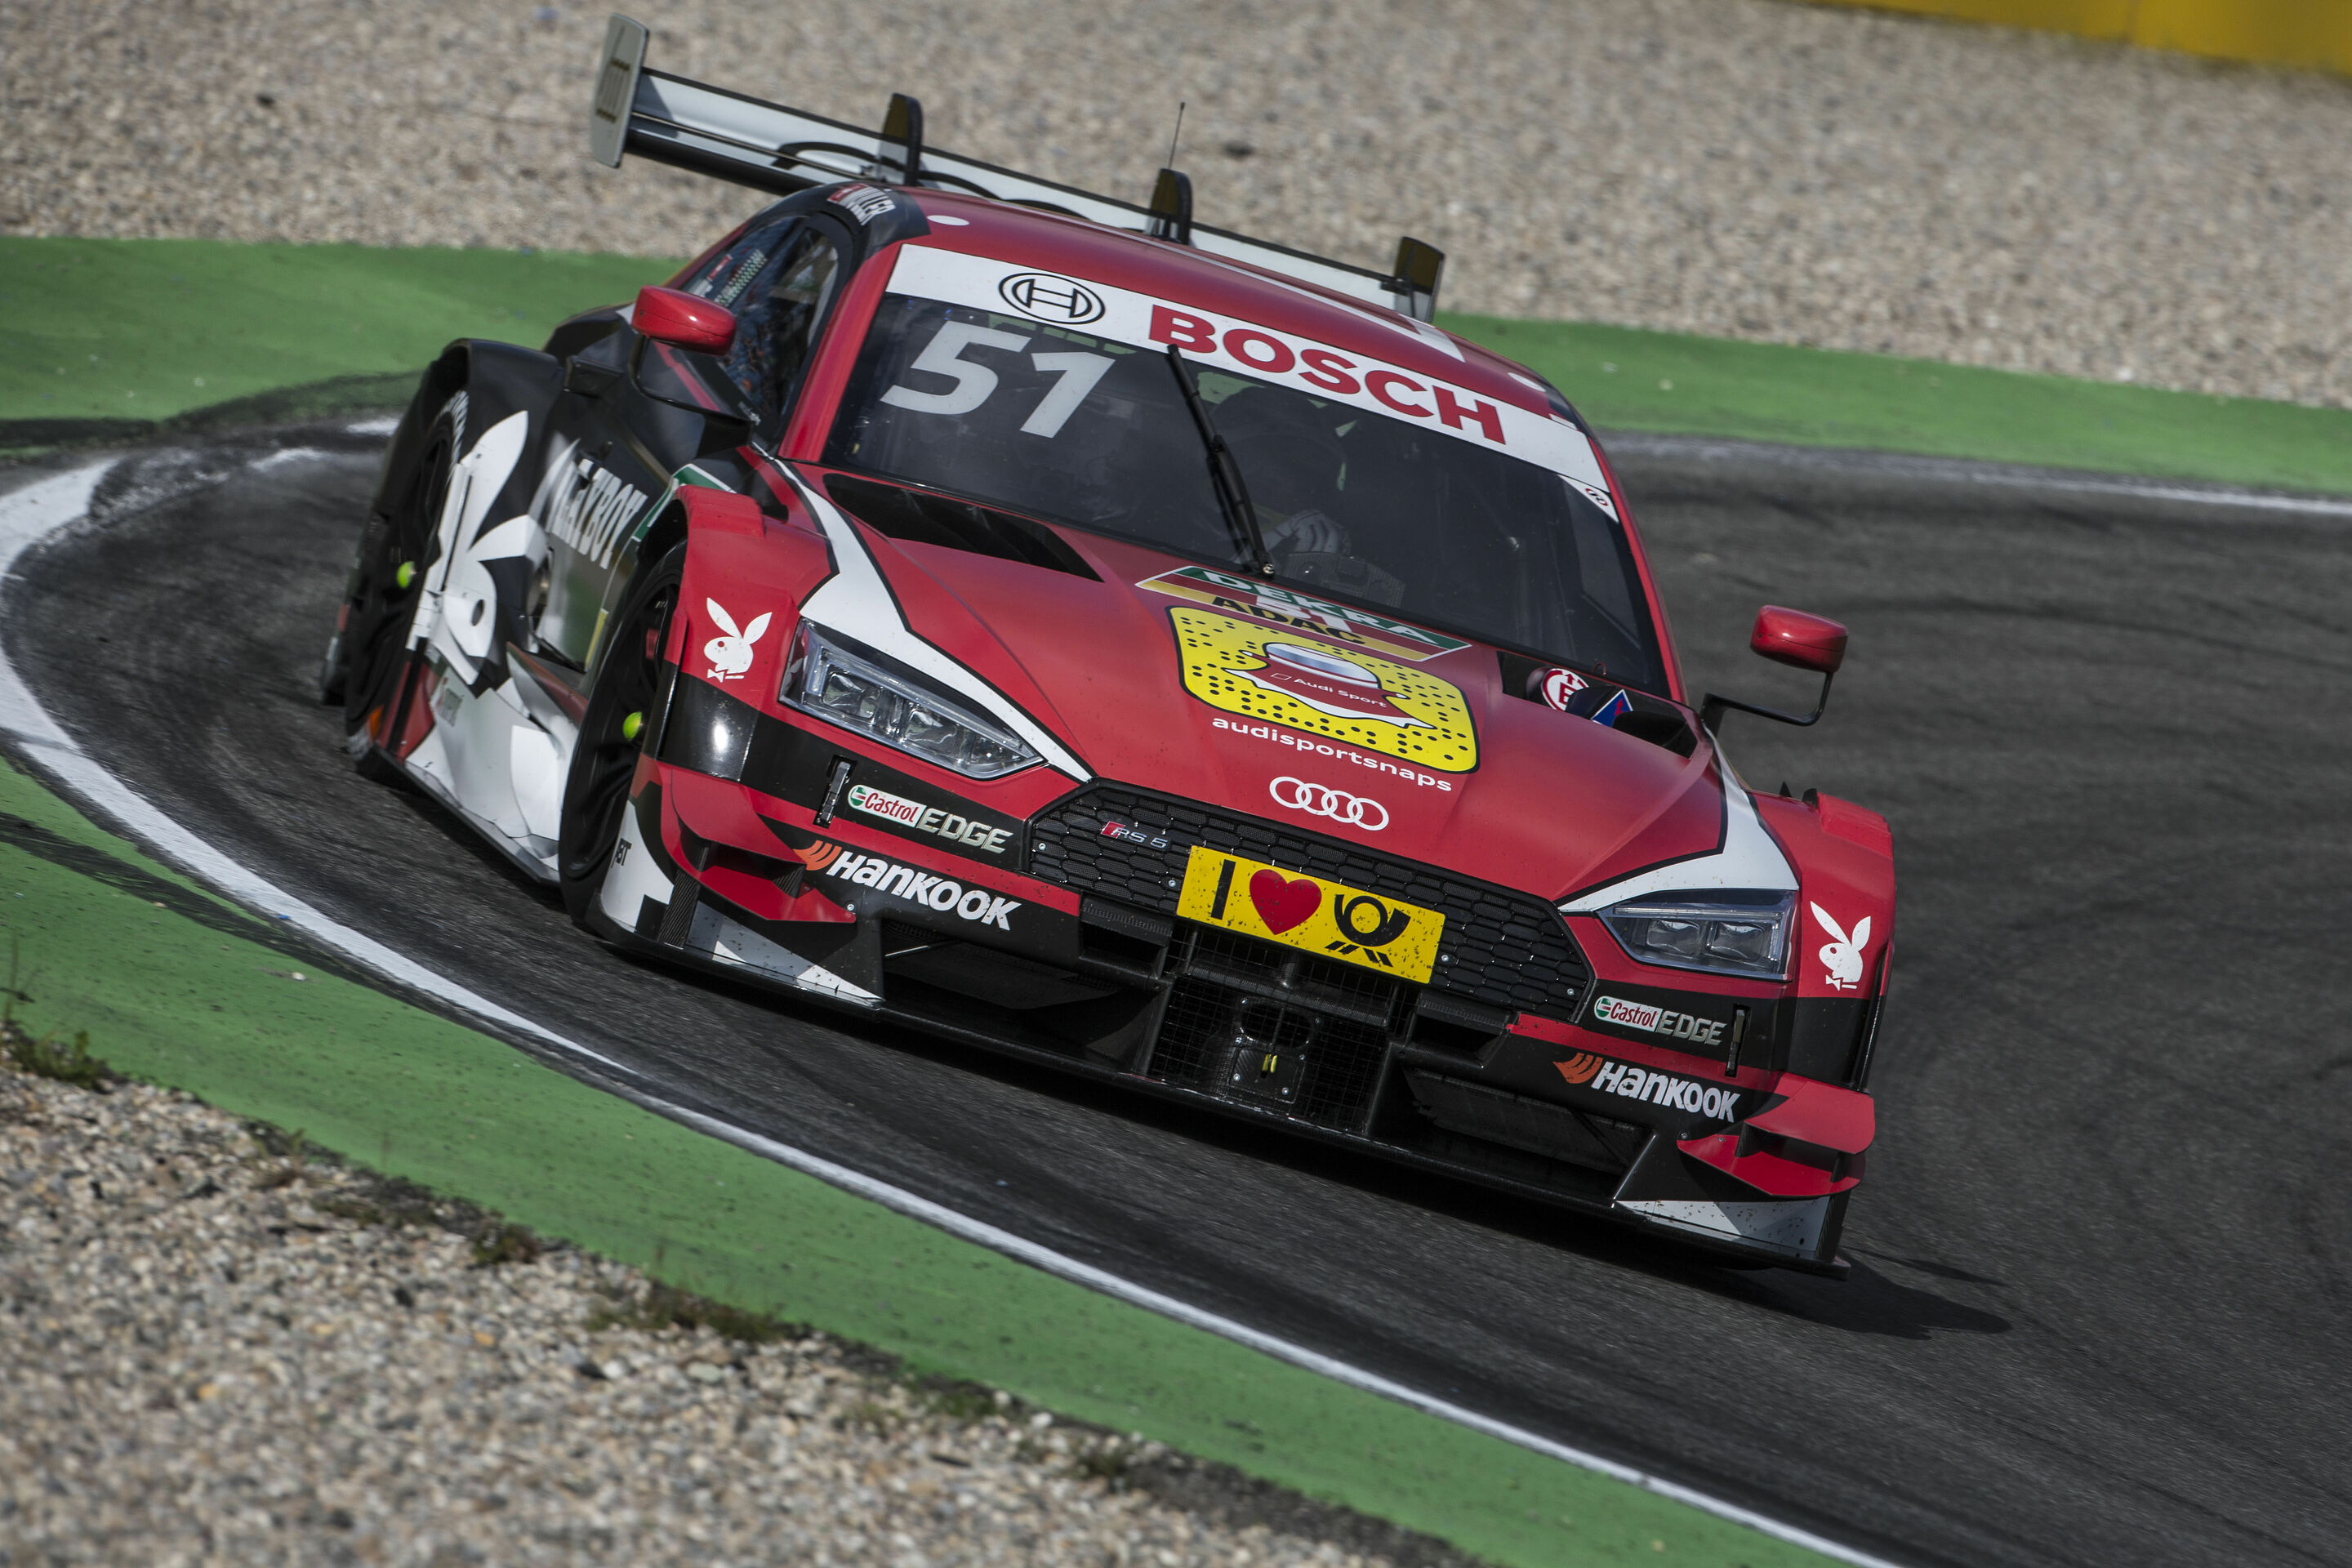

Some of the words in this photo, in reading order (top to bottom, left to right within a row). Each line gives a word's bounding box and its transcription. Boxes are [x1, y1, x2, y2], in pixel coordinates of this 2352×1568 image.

[880, 321, 1116, 439] 51
[1148, 305, 1506, 445] BOSCH
[1203, 571, 1441, 646] DEKRA
[1211, 596, 1366, 645] ADAC
[1294, 679, 1334, 693] Audi
[1338, 690, 1388, 708] Sport
[1212, 718, 1452, 792] audisportsnaps
[865, 792, 919, 822] Castrol
[915, 808, 1013, 854] EDGE
[1111, 827, 1147, 843] RS
[1150, 837, 1168, 849] 5
[1610, 1003, 1658, 1027] Castrol
[1655, 1010, 1727, 1046] EDGE
